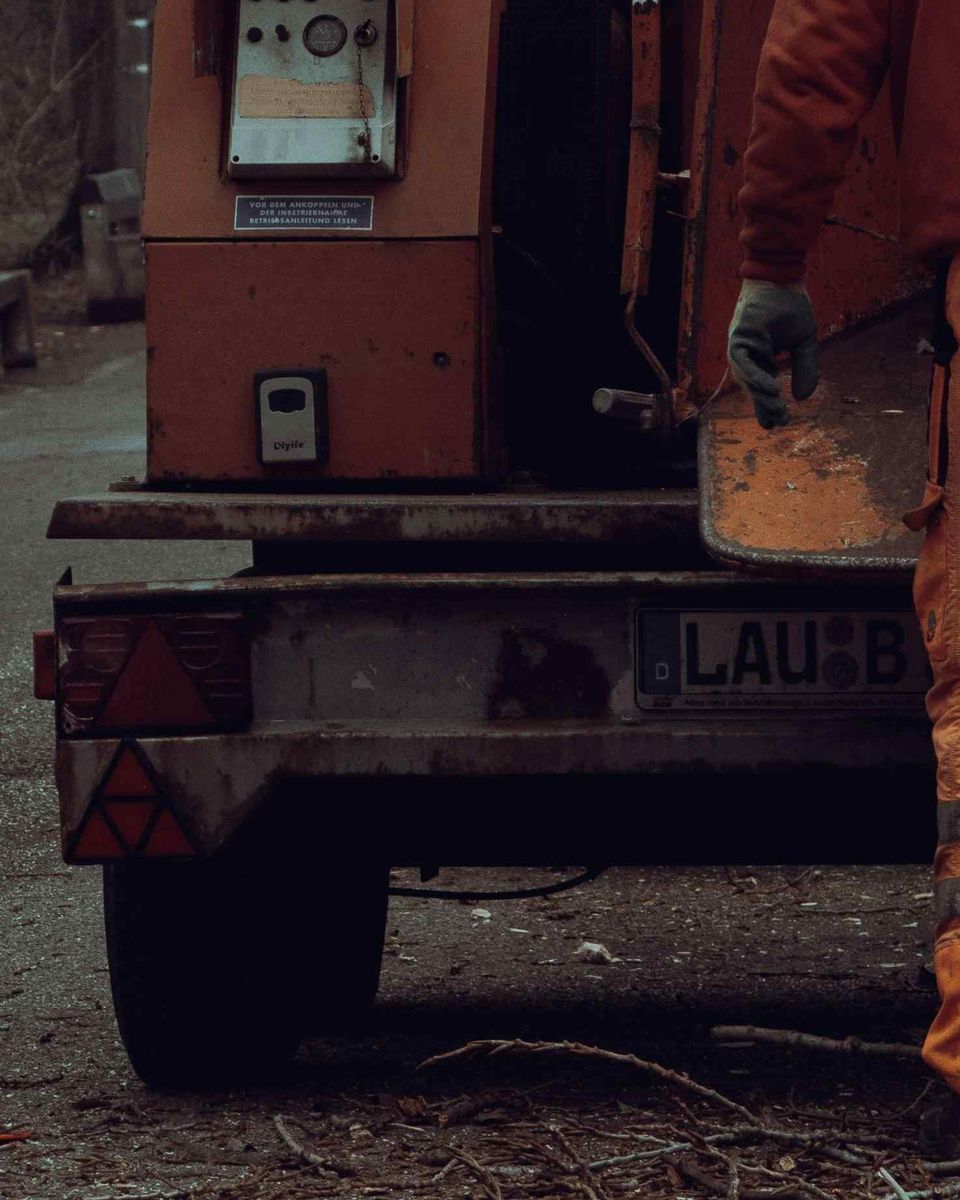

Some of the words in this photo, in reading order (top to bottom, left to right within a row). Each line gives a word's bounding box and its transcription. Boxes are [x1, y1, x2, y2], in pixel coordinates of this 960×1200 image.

[654, 661, 671, 681] D
[686, 620, 817, 685] LAU
[866, 618, 908, 684] B
